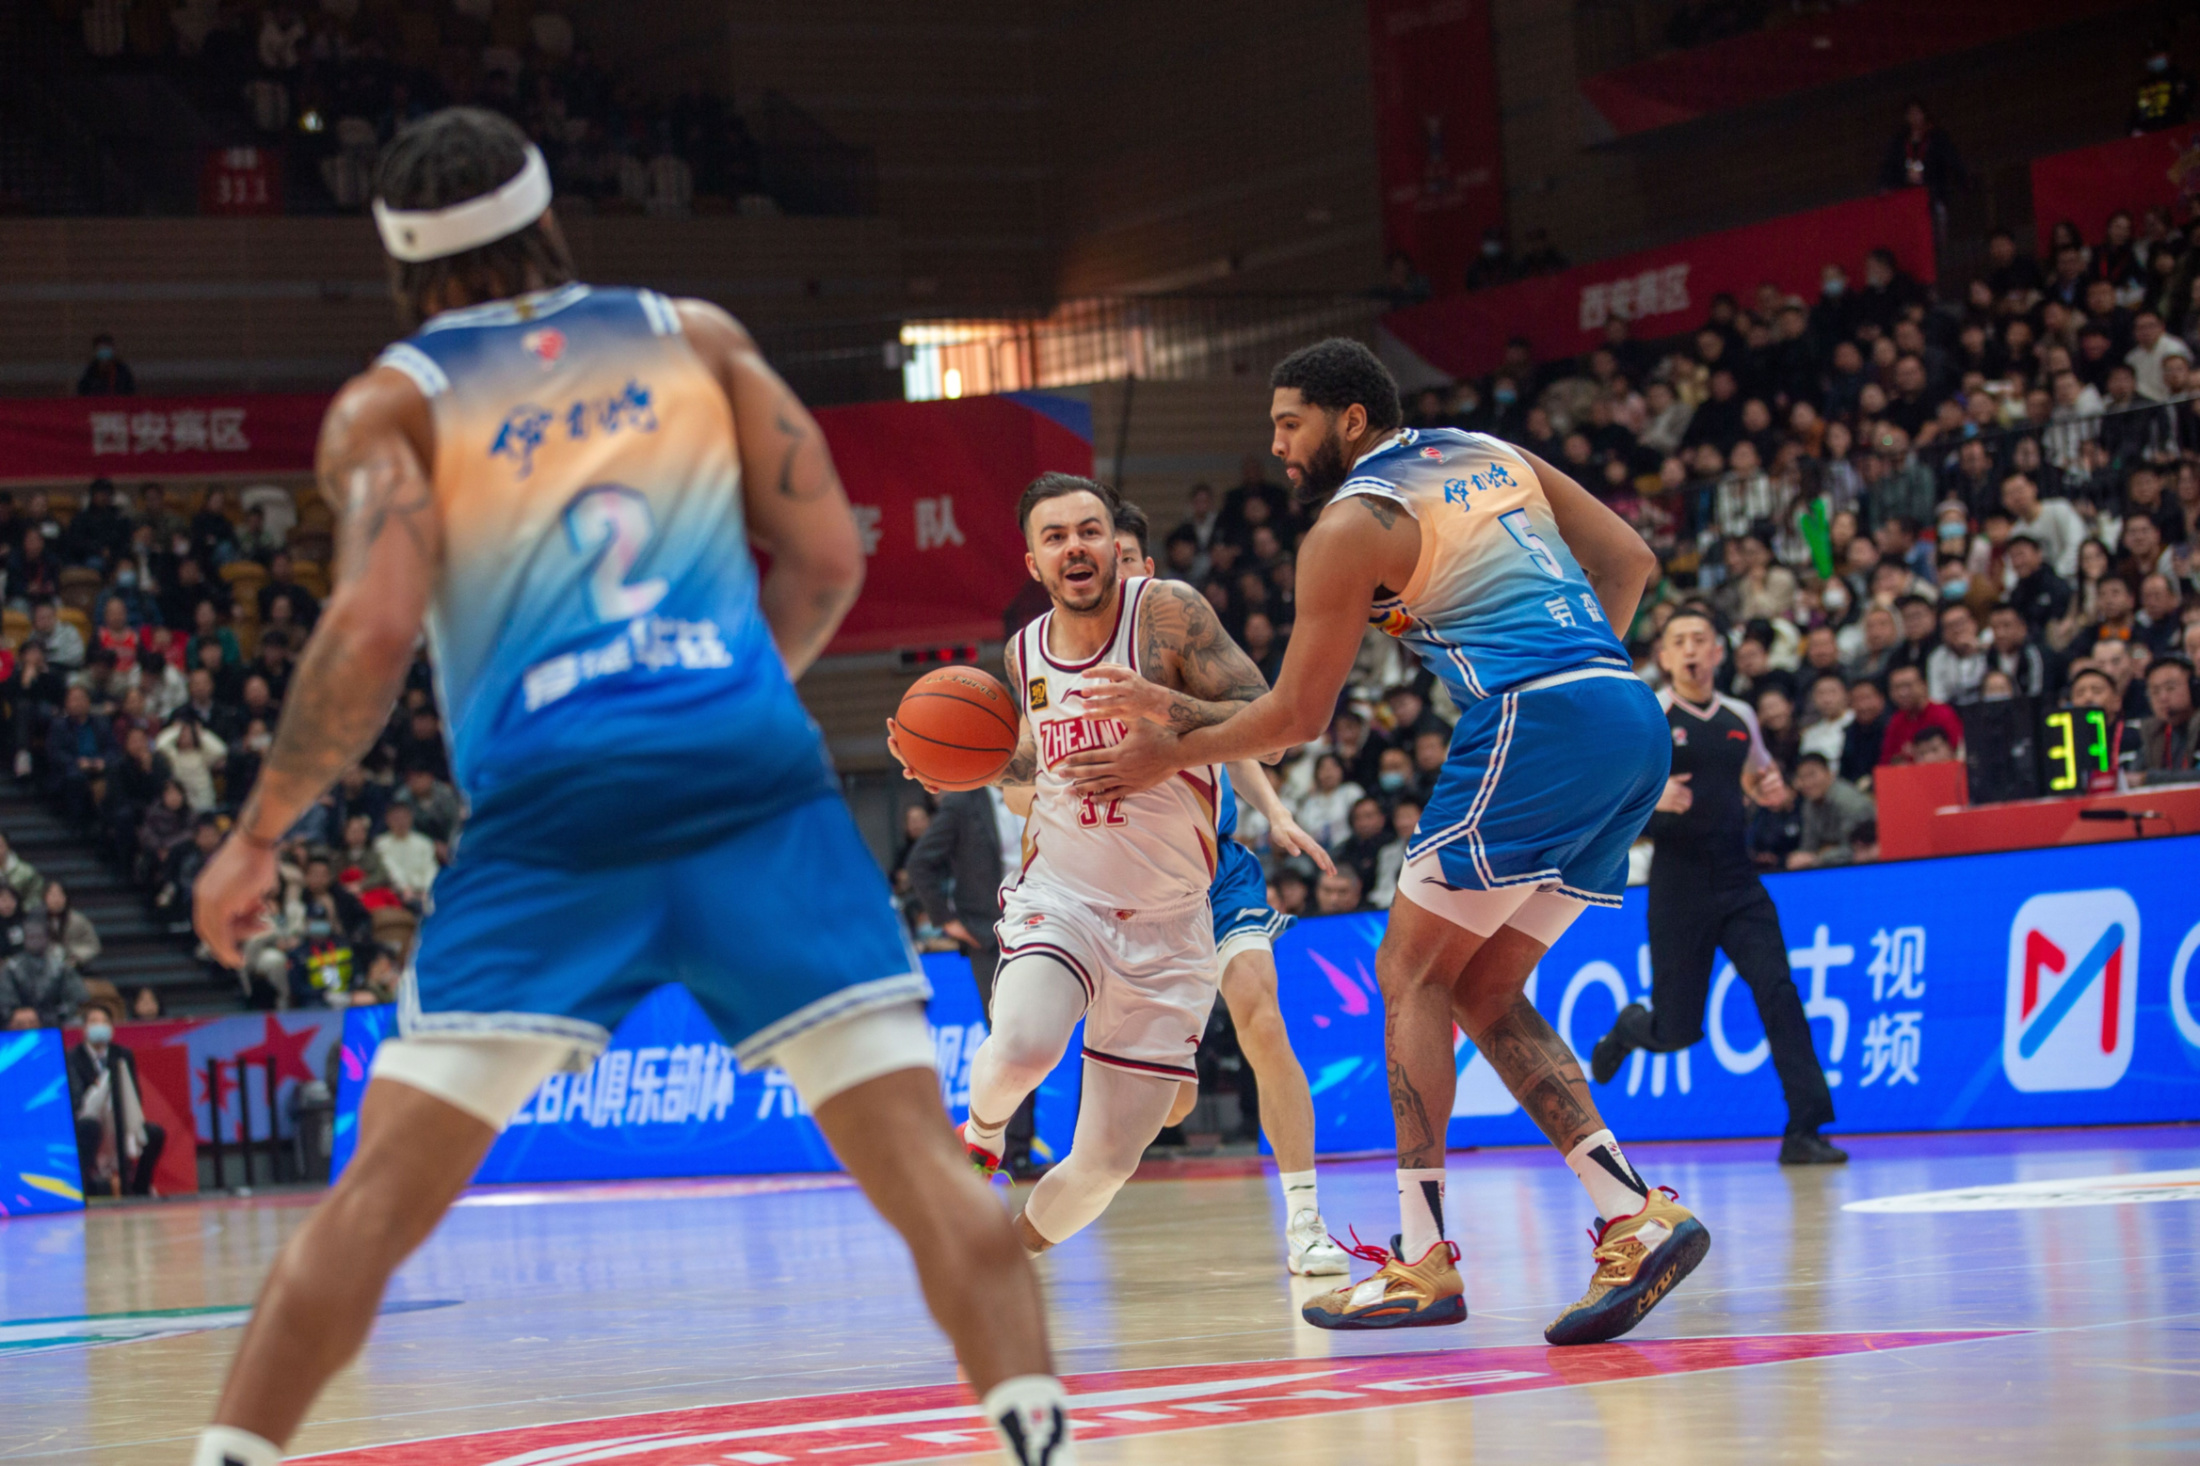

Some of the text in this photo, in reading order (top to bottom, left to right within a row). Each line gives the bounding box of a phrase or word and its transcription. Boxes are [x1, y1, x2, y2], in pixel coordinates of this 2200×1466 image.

[562, 484, 668, 622] 2
[1497, 507, 1563, 579] 5
[1860, 925, 1926, 1088] 视频
